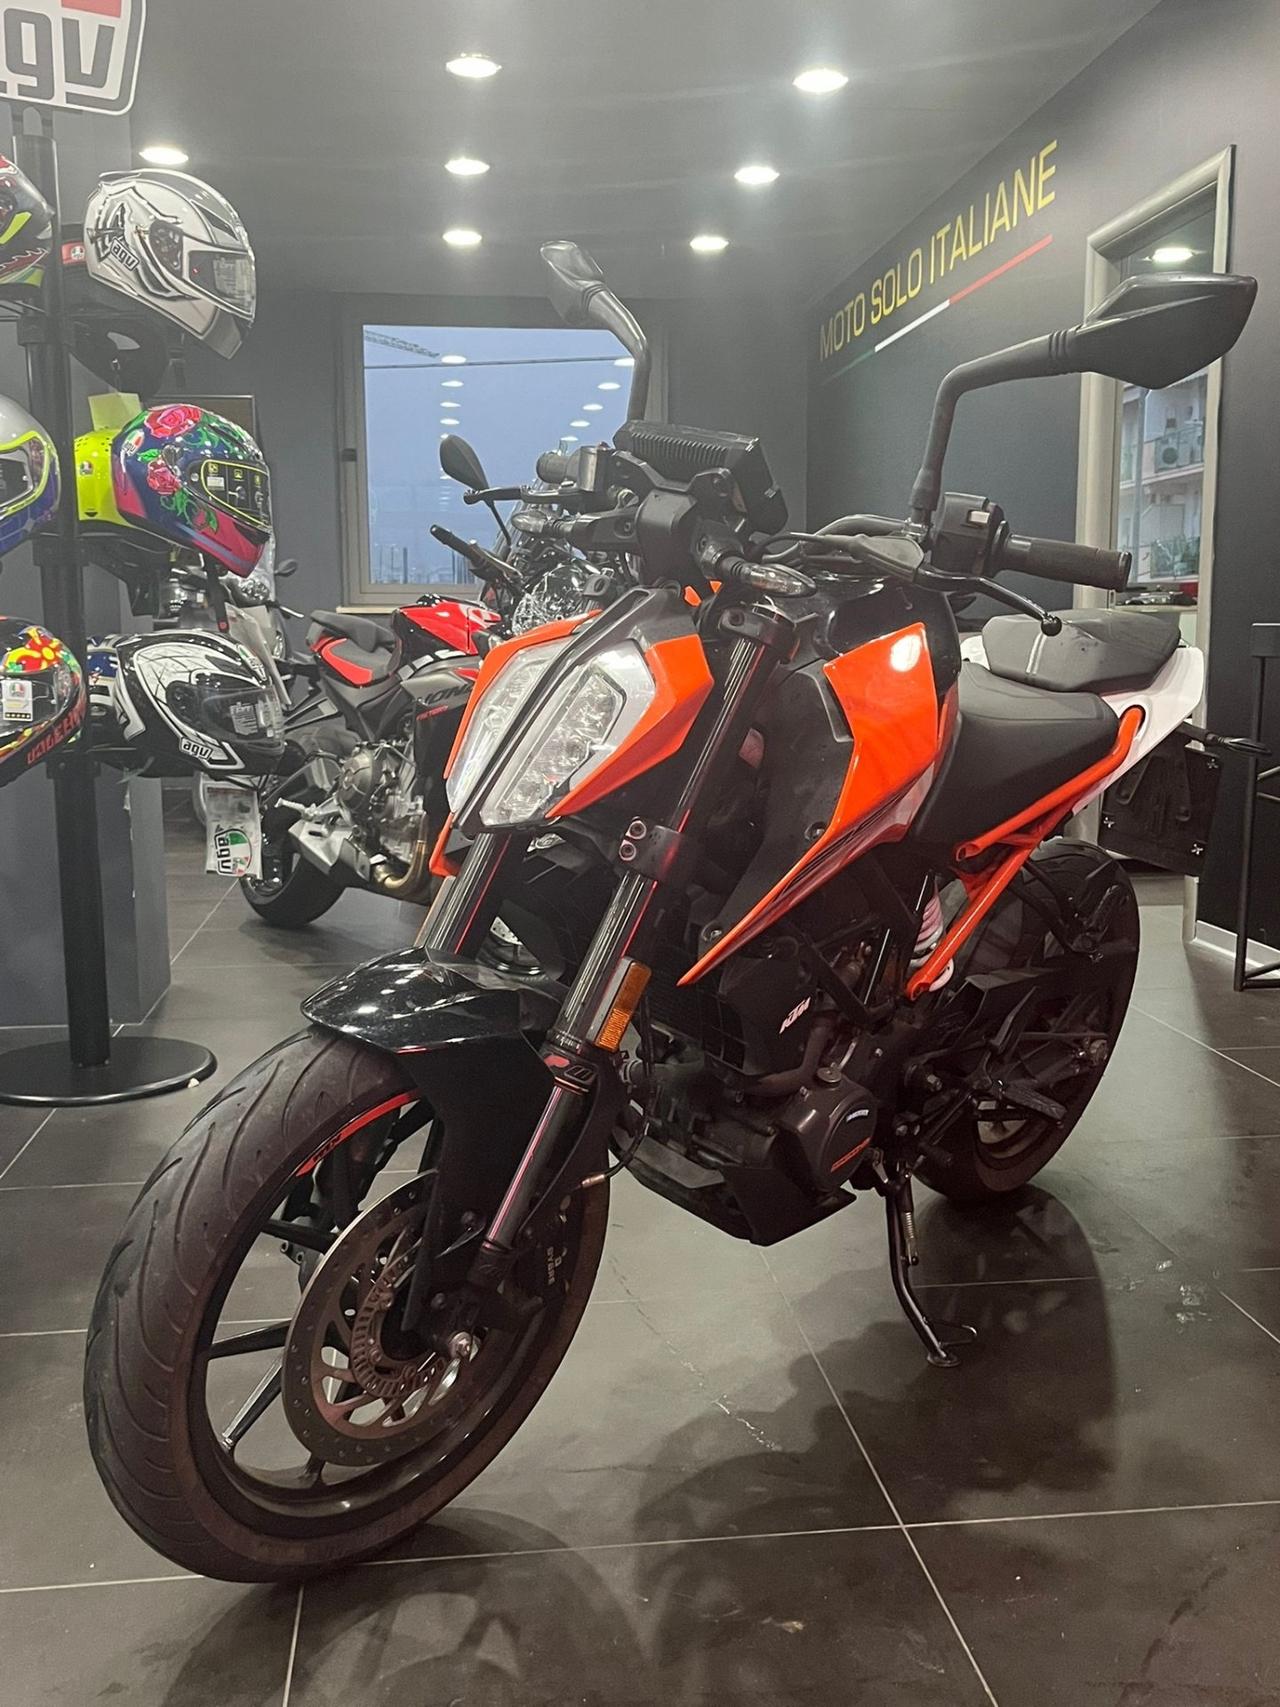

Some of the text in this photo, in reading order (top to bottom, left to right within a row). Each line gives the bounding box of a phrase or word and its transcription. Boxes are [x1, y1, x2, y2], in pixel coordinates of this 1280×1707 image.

[0, 8, 116, 101] gv
[112, 243, 135, 267] agv
[819, 139, 1058, 362] MOTO SOLO ITALIANE
[182, 741, 209, 757] agv
[217, 836, 232, 870] agv
